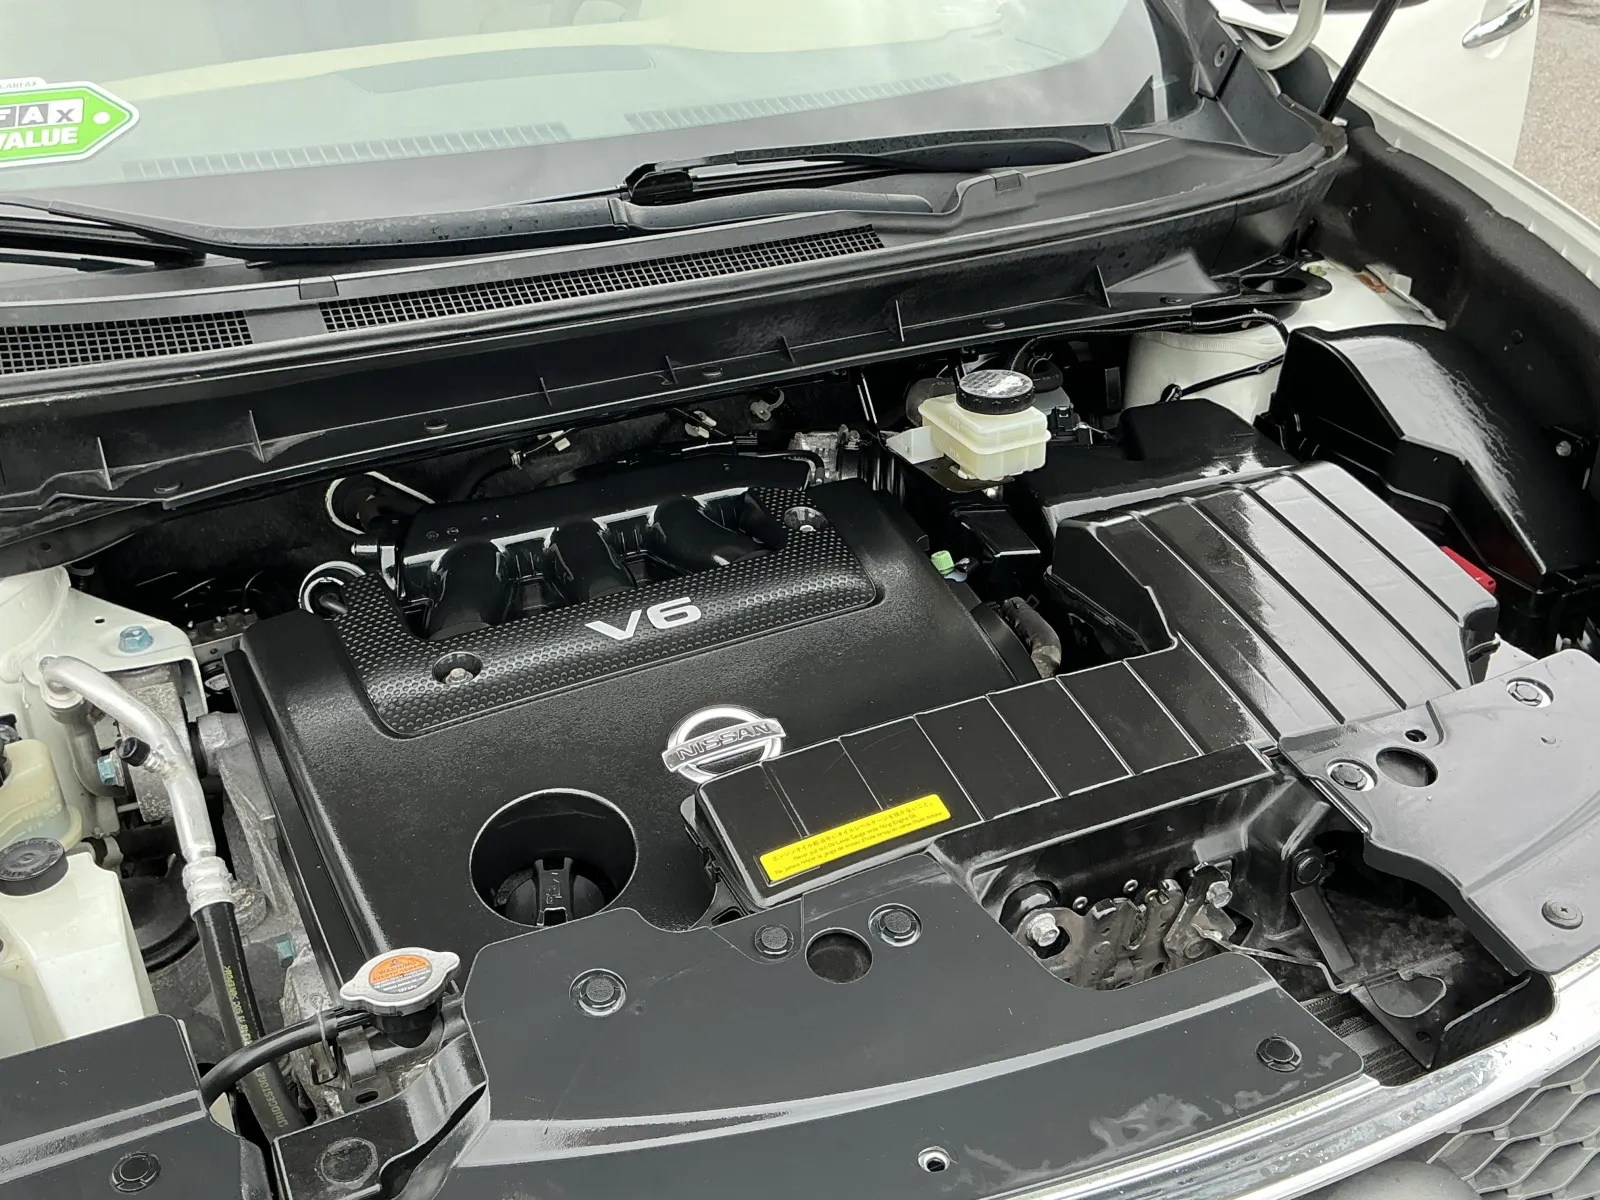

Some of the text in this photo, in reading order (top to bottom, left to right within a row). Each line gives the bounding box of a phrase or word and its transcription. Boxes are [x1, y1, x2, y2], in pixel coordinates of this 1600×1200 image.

[585, 597, 701, 640] V6
[677, 721, 772, 761] NISSAN
[253, 1069, 289, 1129] BRIDGESTONE
